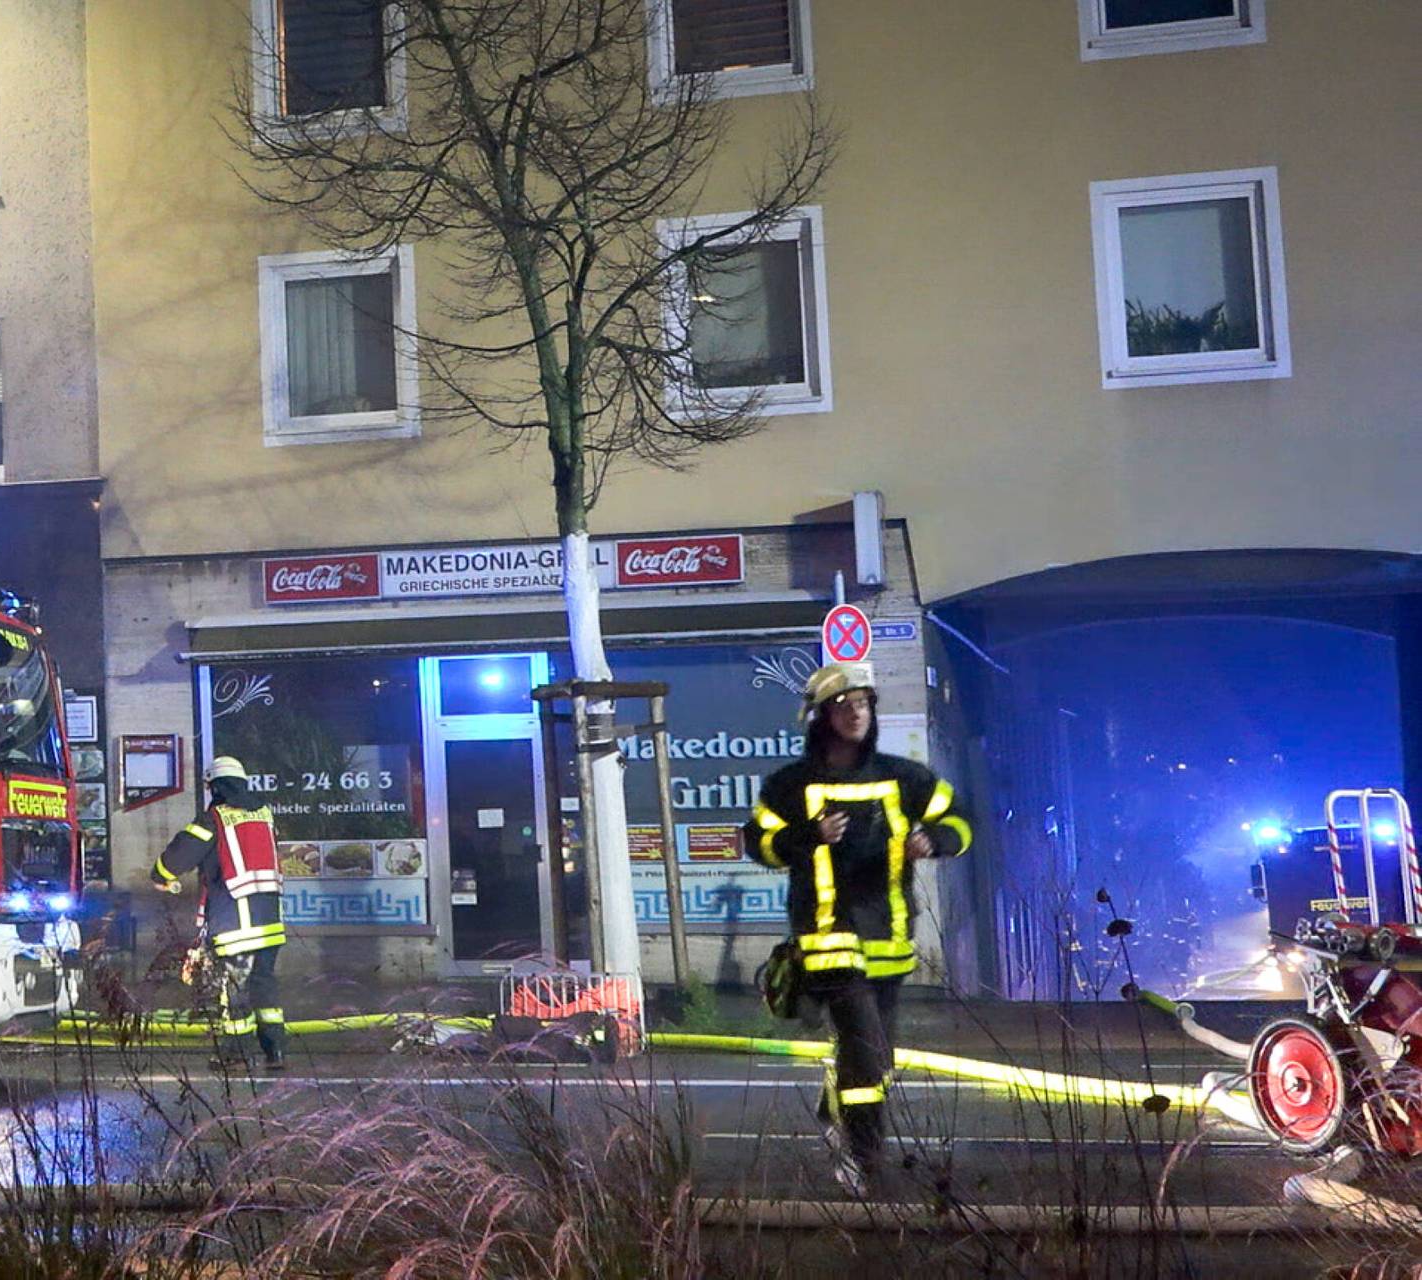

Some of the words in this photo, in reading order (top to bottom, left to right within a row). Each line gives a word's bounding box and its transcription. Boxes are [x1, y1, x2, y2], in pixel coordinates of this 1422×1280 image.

[399, 579, 489, 593] GRIECHISCHE
[247, 775, 277, 792] RE
[302, 771, 332, 791] 24
[339, 771, 370, 790] 66
[379, 771, 392, 789] 3
[671, 774, 761, 809] Grill
[9, 780, 67, 818] Feuerwehr
[318, 801, 406, 815] Spezialitäten
